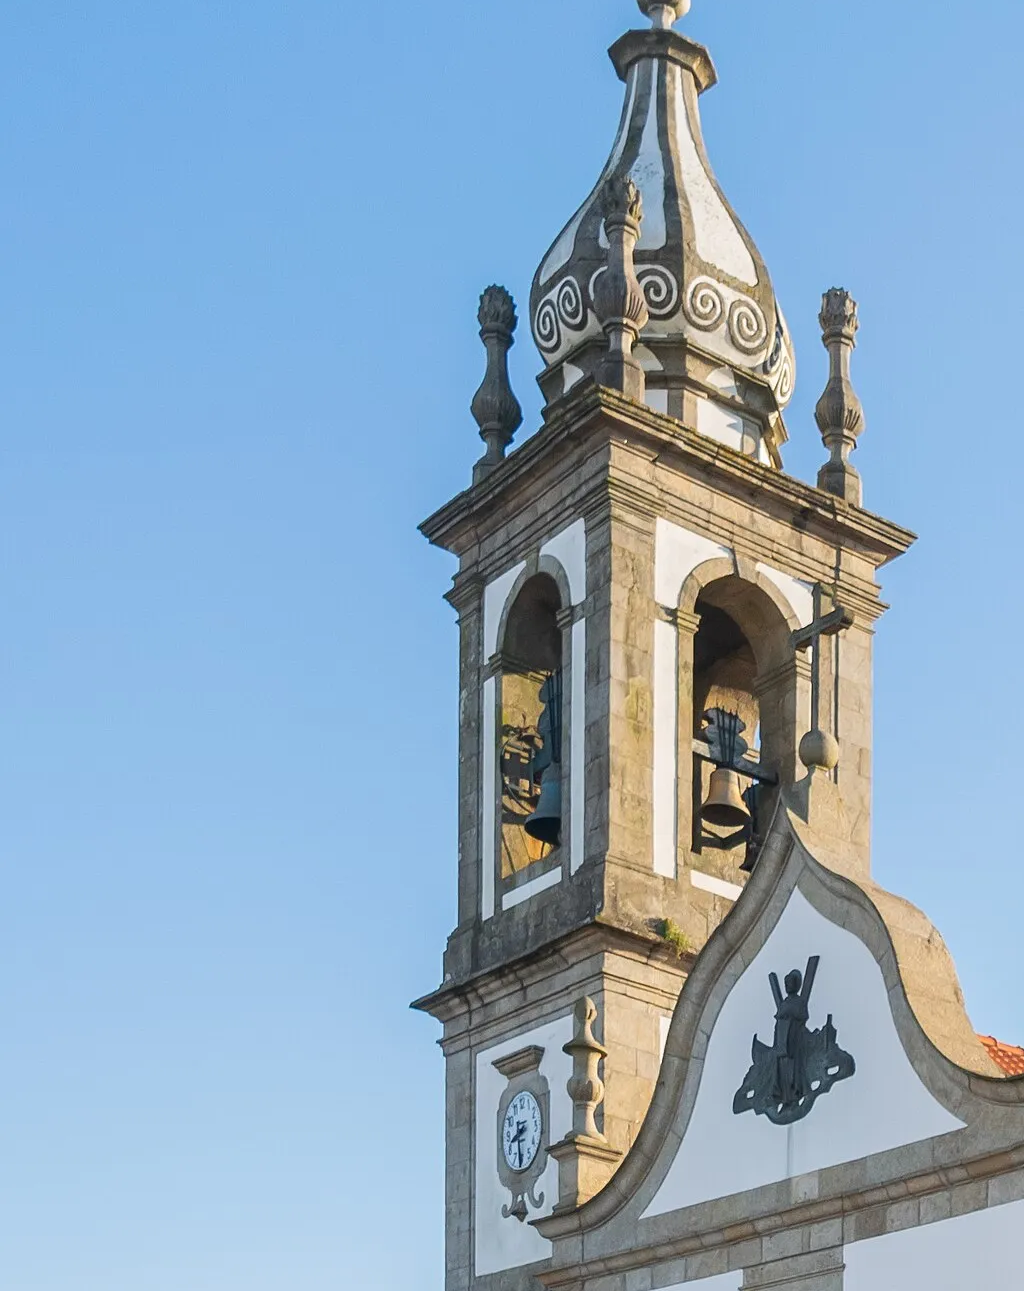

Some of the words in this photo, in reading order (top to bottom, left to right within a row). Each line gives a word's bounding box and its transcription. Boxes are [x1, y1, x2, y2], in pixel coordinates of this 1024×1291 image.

[507, 1116, 514, 1128] 10
[507, 1131, 510, 1142] 9
[513, 1152, 517, 1166] 7
